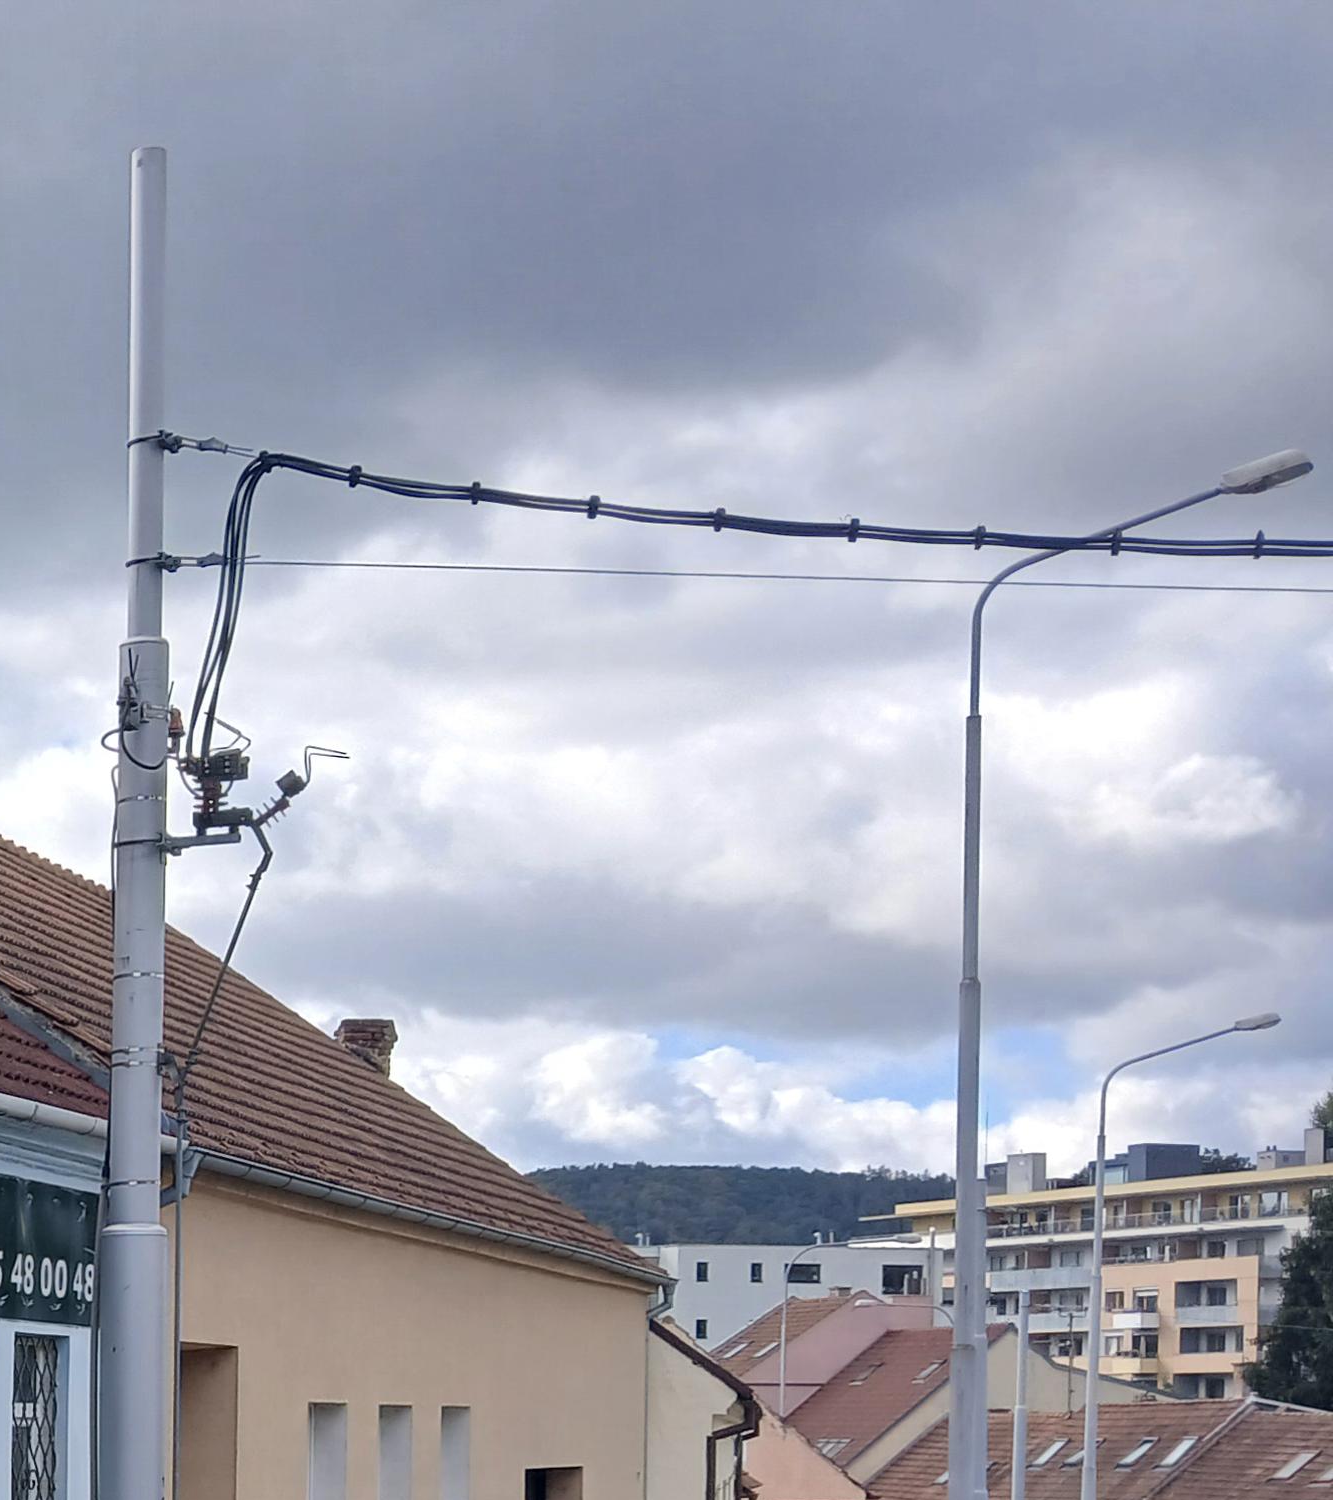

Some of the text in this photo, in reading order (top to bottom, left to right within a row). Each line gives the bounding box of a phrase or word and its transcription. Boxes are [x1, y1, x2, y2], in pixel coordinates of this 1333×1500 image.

[10, 1253, 34, 1295] 48
[40, 1257, 68, 1299] 00
[73, 1262, 95, 1302] 48
